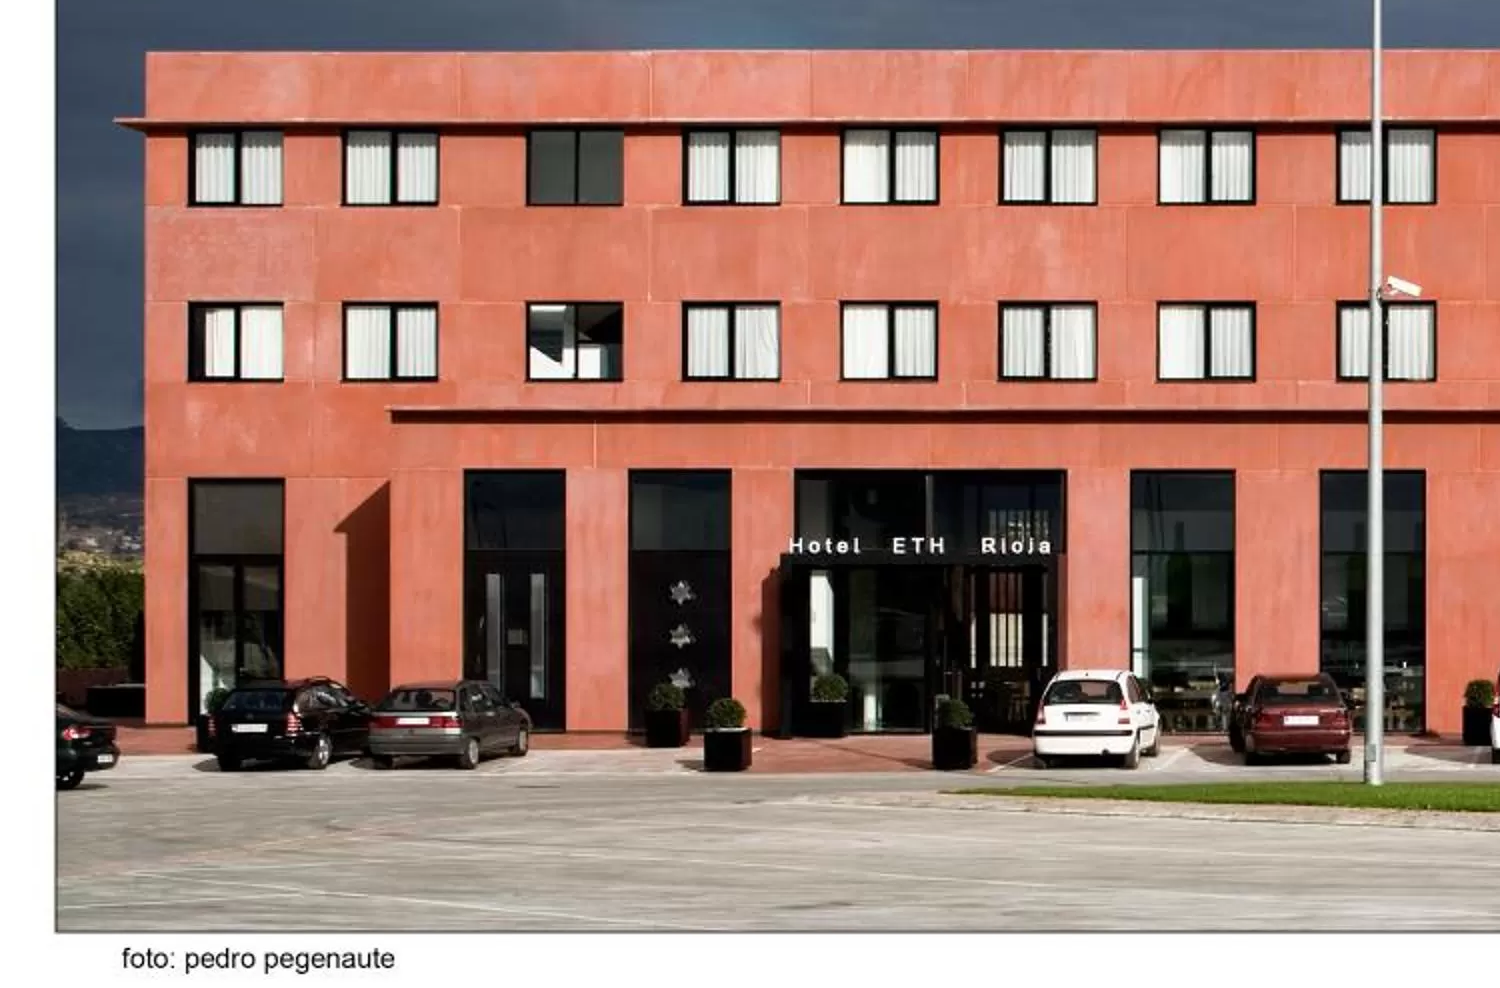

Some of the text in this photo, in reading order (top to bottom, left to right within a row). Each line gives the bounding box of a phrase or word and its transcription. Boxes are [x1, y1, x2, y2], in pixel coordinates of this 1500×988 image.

[788, 537, 1052, 555] Hotel ETH Rioja
